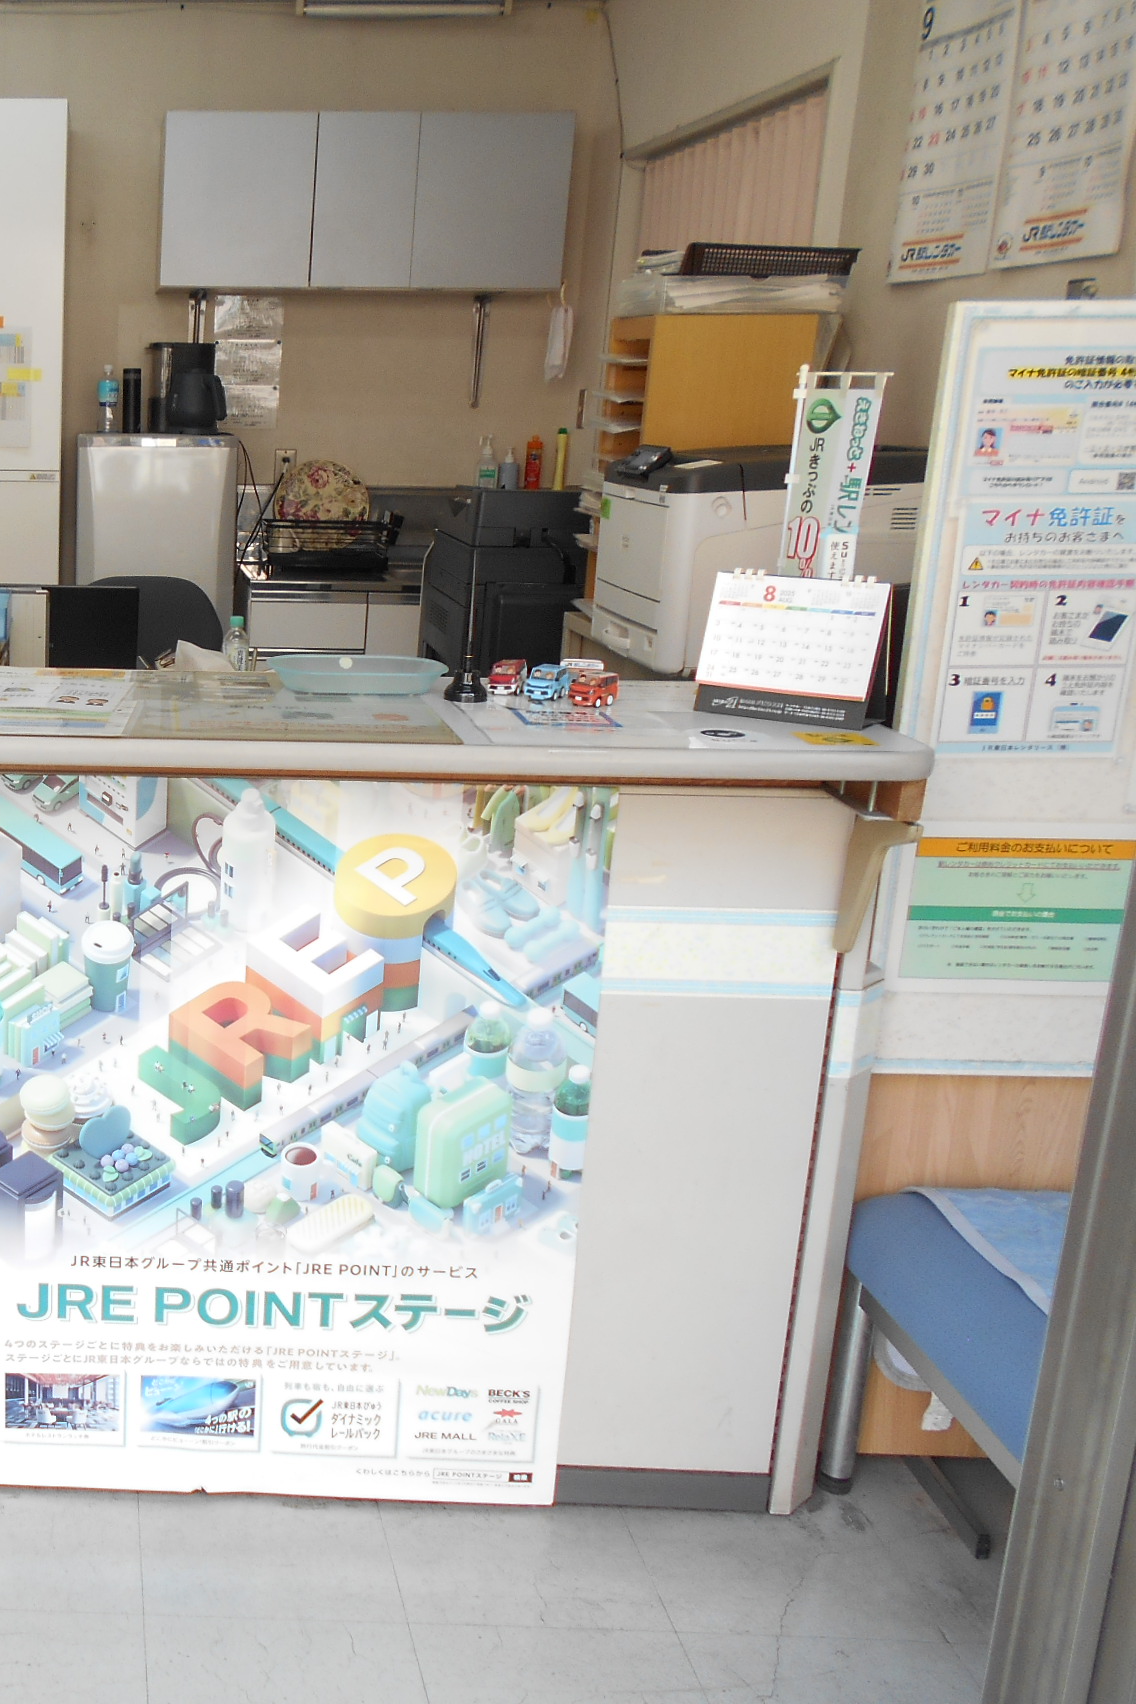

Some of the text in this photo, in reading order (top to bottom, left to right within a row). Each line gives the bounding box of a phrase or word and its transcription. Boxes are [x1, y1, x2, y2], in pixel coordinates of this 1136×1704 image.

[921, 7, 936, 41] 9
[982, 507, 1126, 527] マイナ免許証を
[1004, 532, 1125, 544] お持ちのお客さまへ
[763, 585, 777, 602] 8
[1055, 594, 1068, 606] 2
[958, 596, 970, 607] 1
[948, 674, 961, 686] 3
[964, 677, 1025, 686] 暗証番号を入力
[1044, 673, 1057, 687] 4
[956, 842, 1114, 855] ご利用料金のお支払いについて
[71, 1254, 478, 1279] JR東日本グループ共通ポイント「JRE POINT」のサービス
[16, 1283, 531, 1334] JRE POINTステージ
[284, 1381, 385, 1393] 列車も宿も、自由に選ぶ
[415, 1384, 479, 1399] NewDays
[331, 1412, 382, 1427] ダイナミック
[417, 1409, 473, 1422] acure
[414, 1431, 477, 1441] JRE MALL
